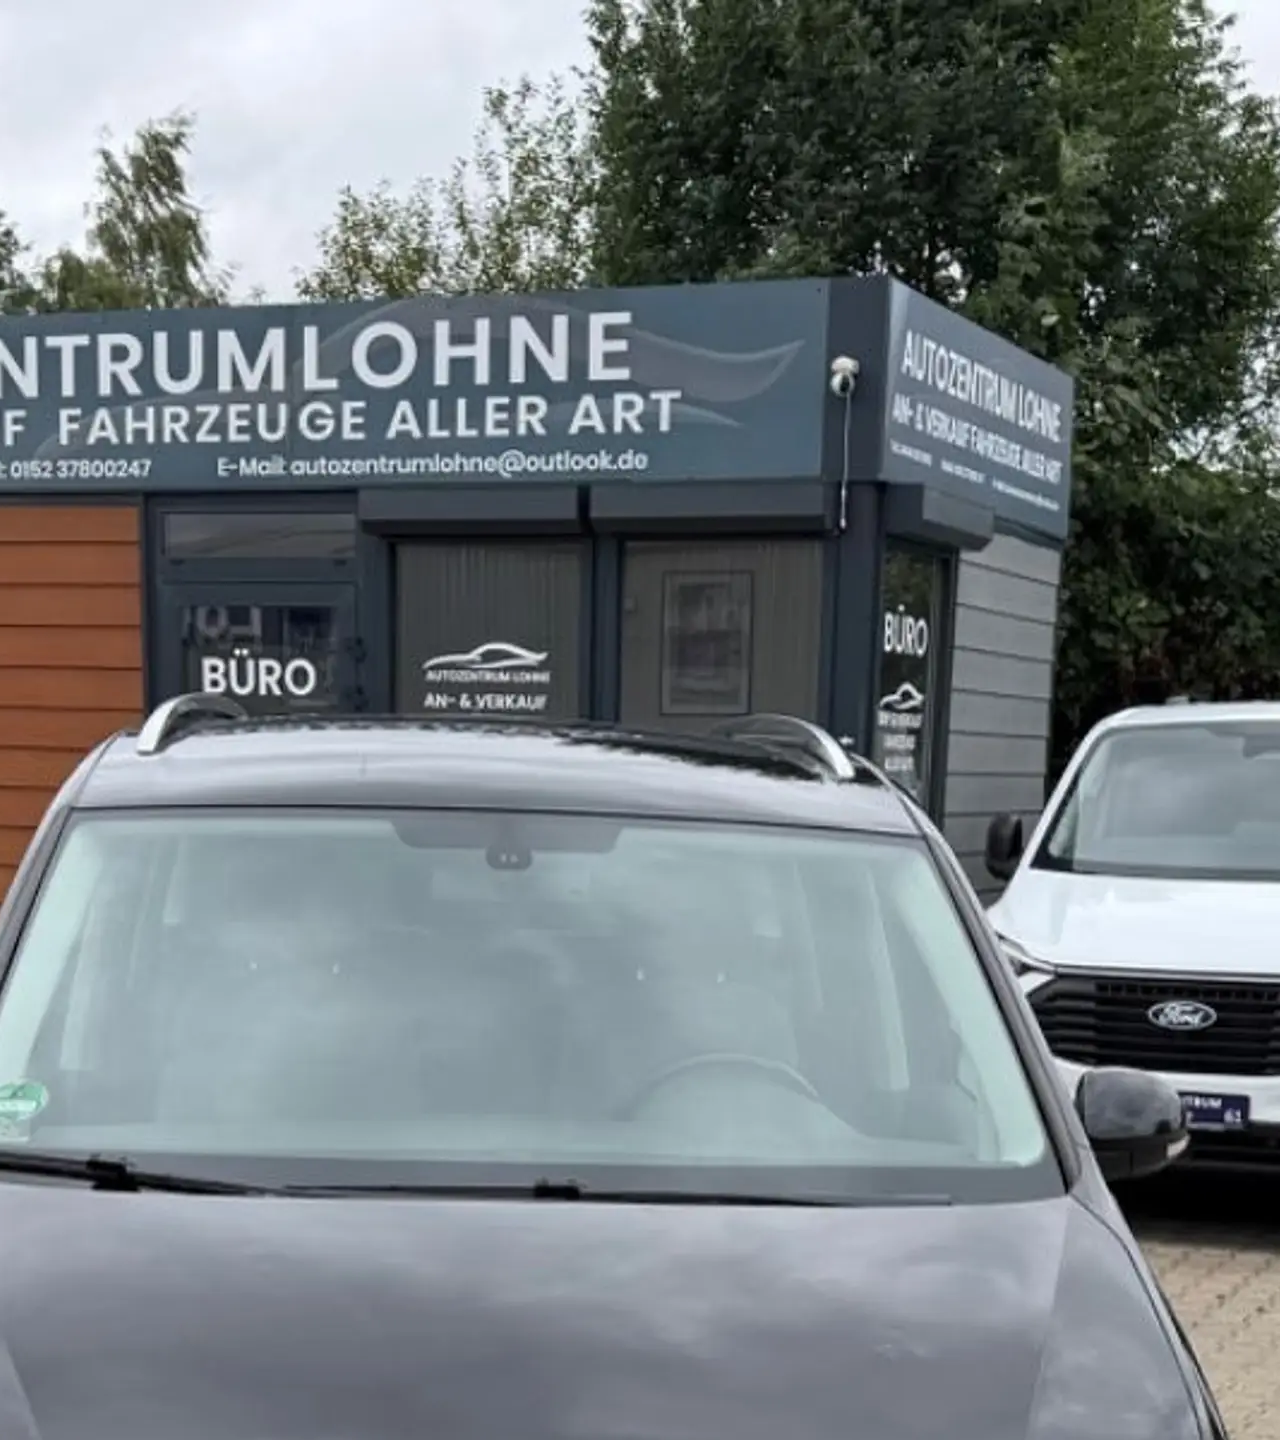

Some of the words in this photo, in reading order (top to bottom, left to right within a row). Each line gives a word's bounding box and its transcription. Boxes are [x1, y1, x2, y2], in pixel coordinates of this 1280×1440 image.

[57, 401, 367, 446] FAHRZEUGE
[385, 396, 548, 440] ALLER
[567, 390, 683, 435] ART
[56, 458, 152, 479] 37800247
[290, 449, 649, 479] autozentrumlohne@outlook.de
[201, 647, 317, 696] BÜRO
